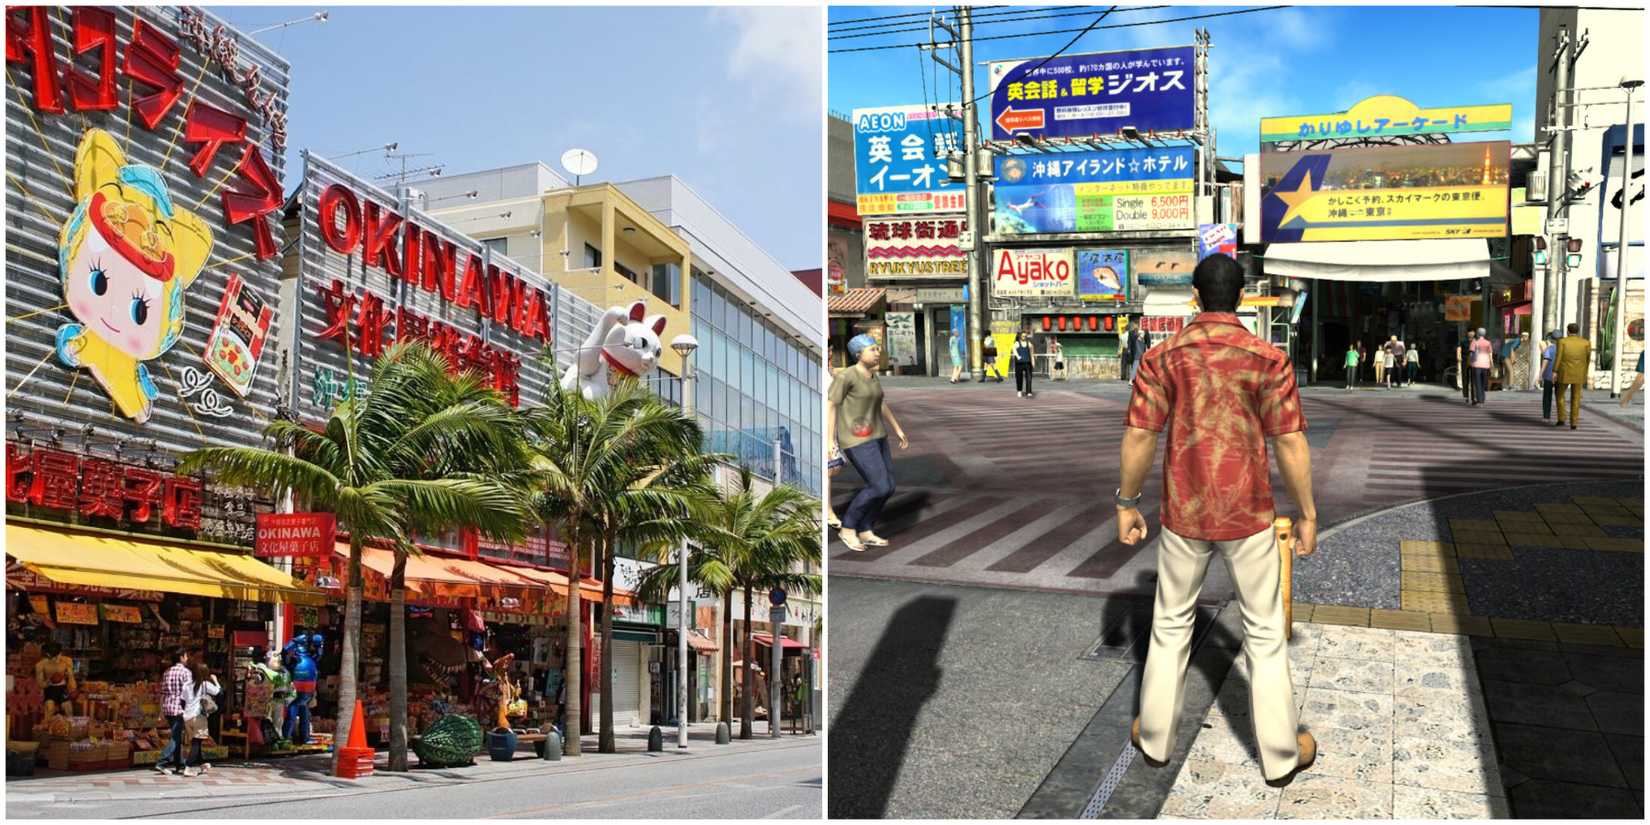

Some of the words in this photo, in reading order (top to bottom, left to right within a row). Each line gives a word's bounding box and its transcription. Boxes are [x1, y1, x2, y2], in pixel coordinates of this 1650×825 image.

[1108, 71, 1186, 95] ジオス
[860, 113, 905, 130] AEON
[1299, 113, 1468, 137] かりゆしアーケード
[1117, 197, 1144, 210] Single
[1151, 196, 1189, 207] 6,500円
[1116, 209, 1148, 221] Double
[1151, 208, 1189, 220] 9,000円
[318, 183, 553, 345] OKINAWA
[997, 250, 1069, 285] Ayako
[258, 526, 321, 540] OKINAWA
